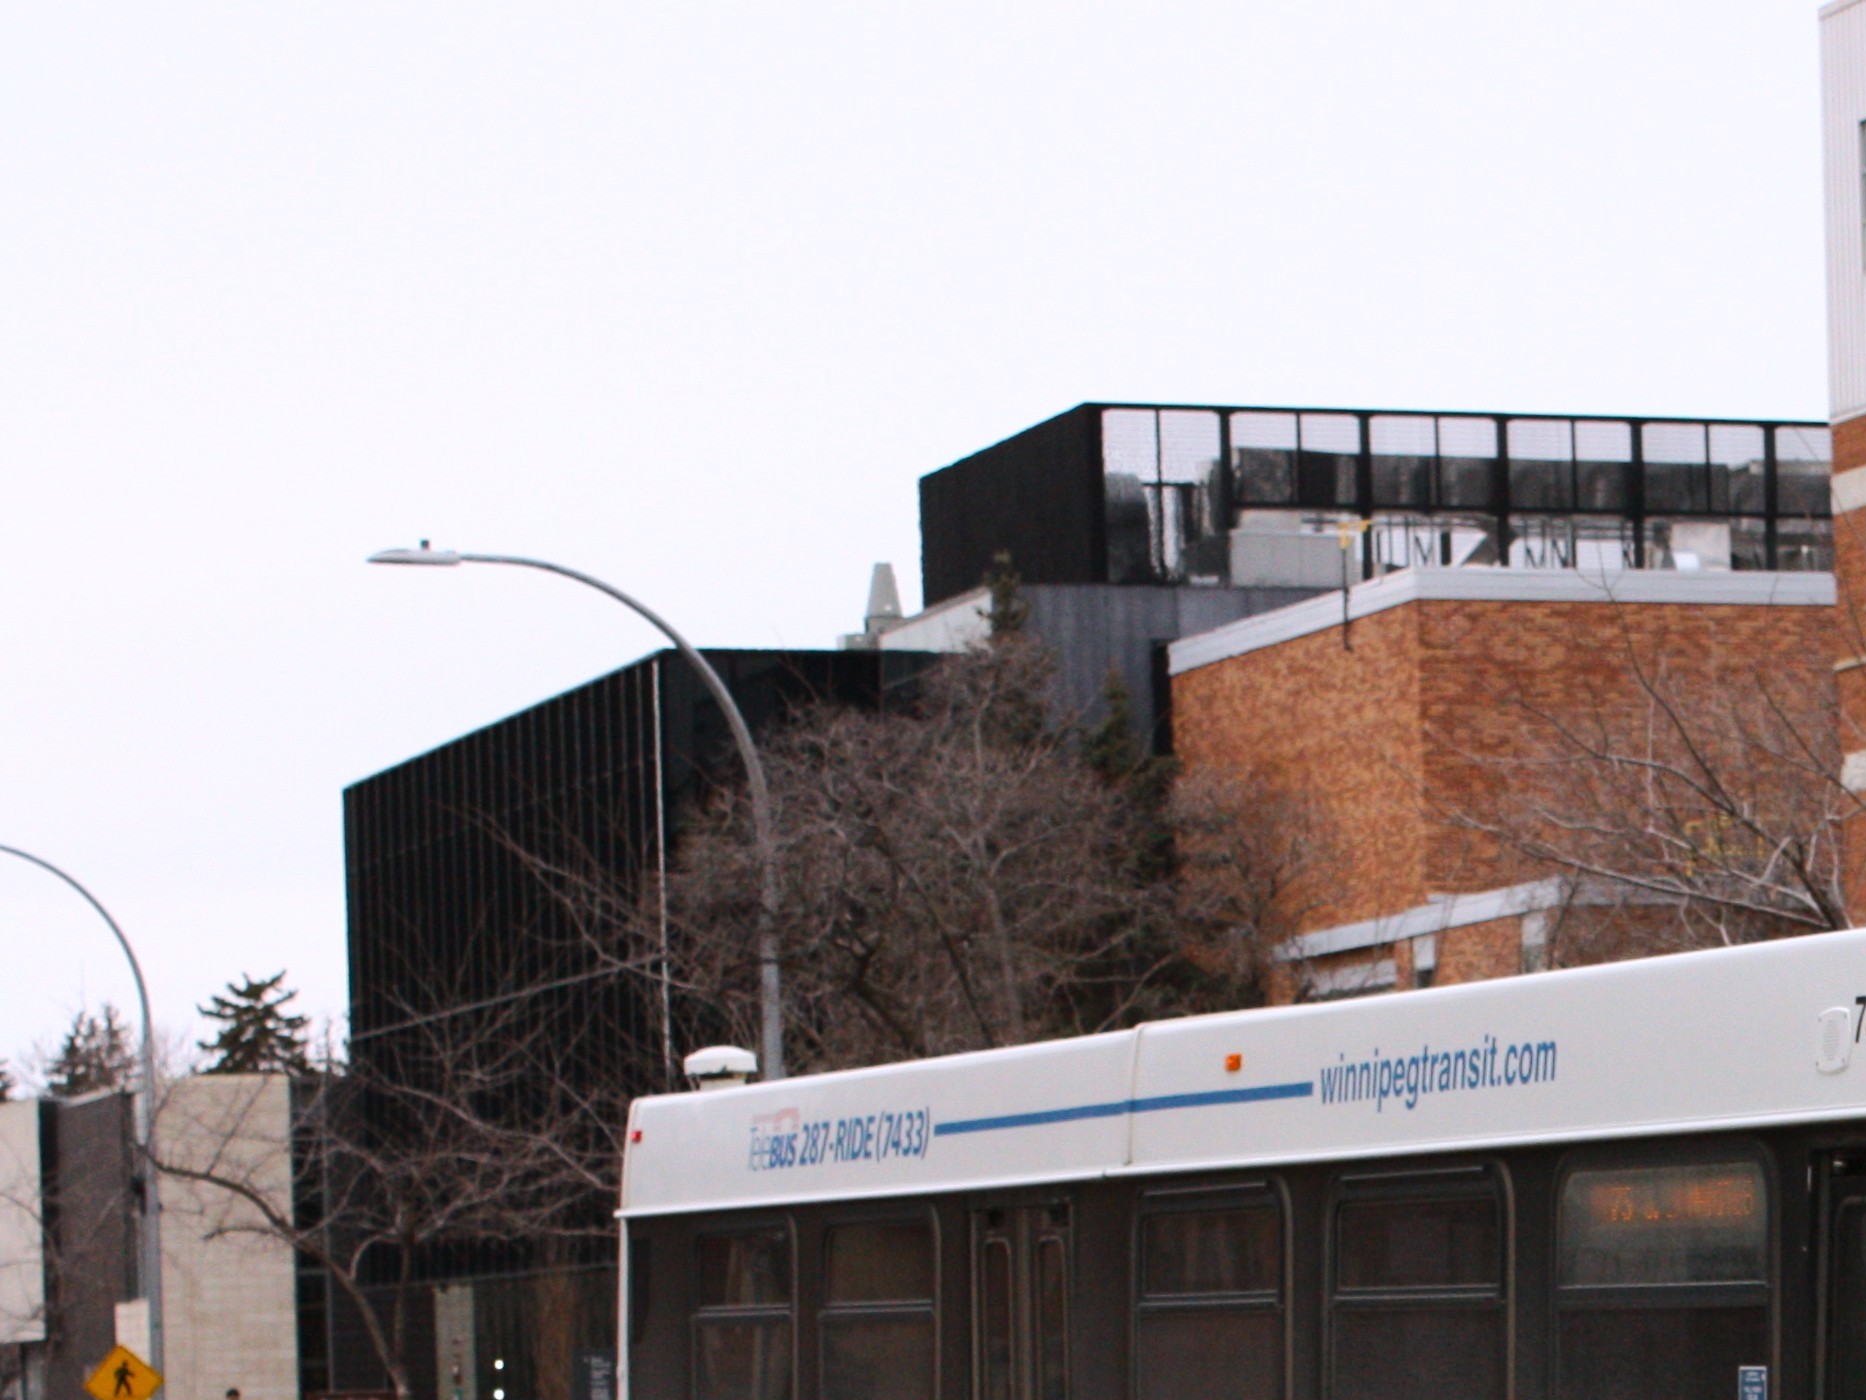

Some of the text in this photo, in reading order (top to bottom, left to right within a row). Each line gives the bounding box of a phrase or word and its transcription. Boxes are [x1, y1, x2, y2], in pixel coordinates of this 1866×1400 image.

[1320, 1033, 1557, 1113] winnipegtransit.com
[799, 1115, 876, 1167] 287-RIDE
[876, 1106, 930, 1163] (7433)
